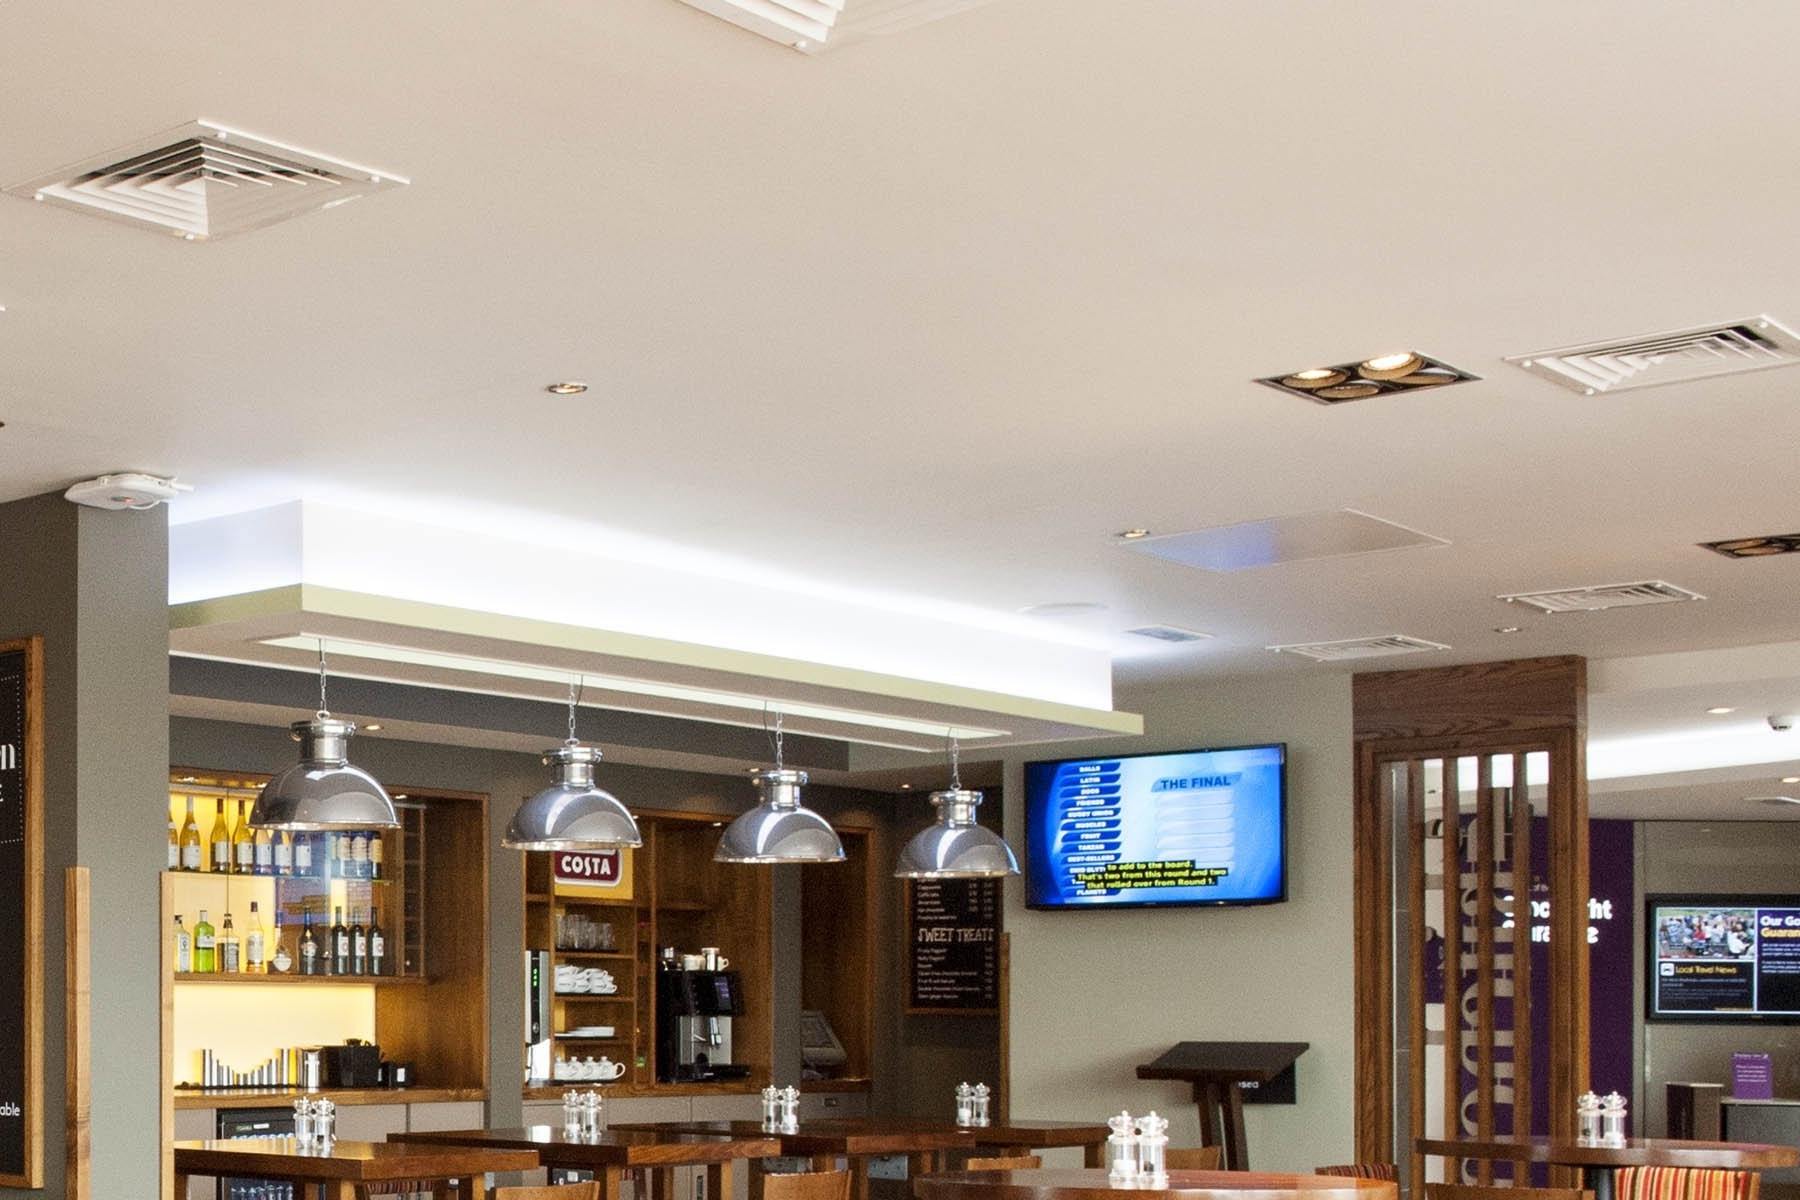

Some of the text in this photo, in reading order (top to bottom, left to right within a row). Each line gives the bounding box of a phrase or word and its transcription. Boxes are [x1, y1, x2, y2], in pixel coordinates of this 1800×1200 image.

[1161, 776, 1231, 790] THE FINAL
[561, 856, 611, 876] COSTA
[1760, 916, 1783, 926] Our
[918, 928, 994, 942] SWEET TREATS
